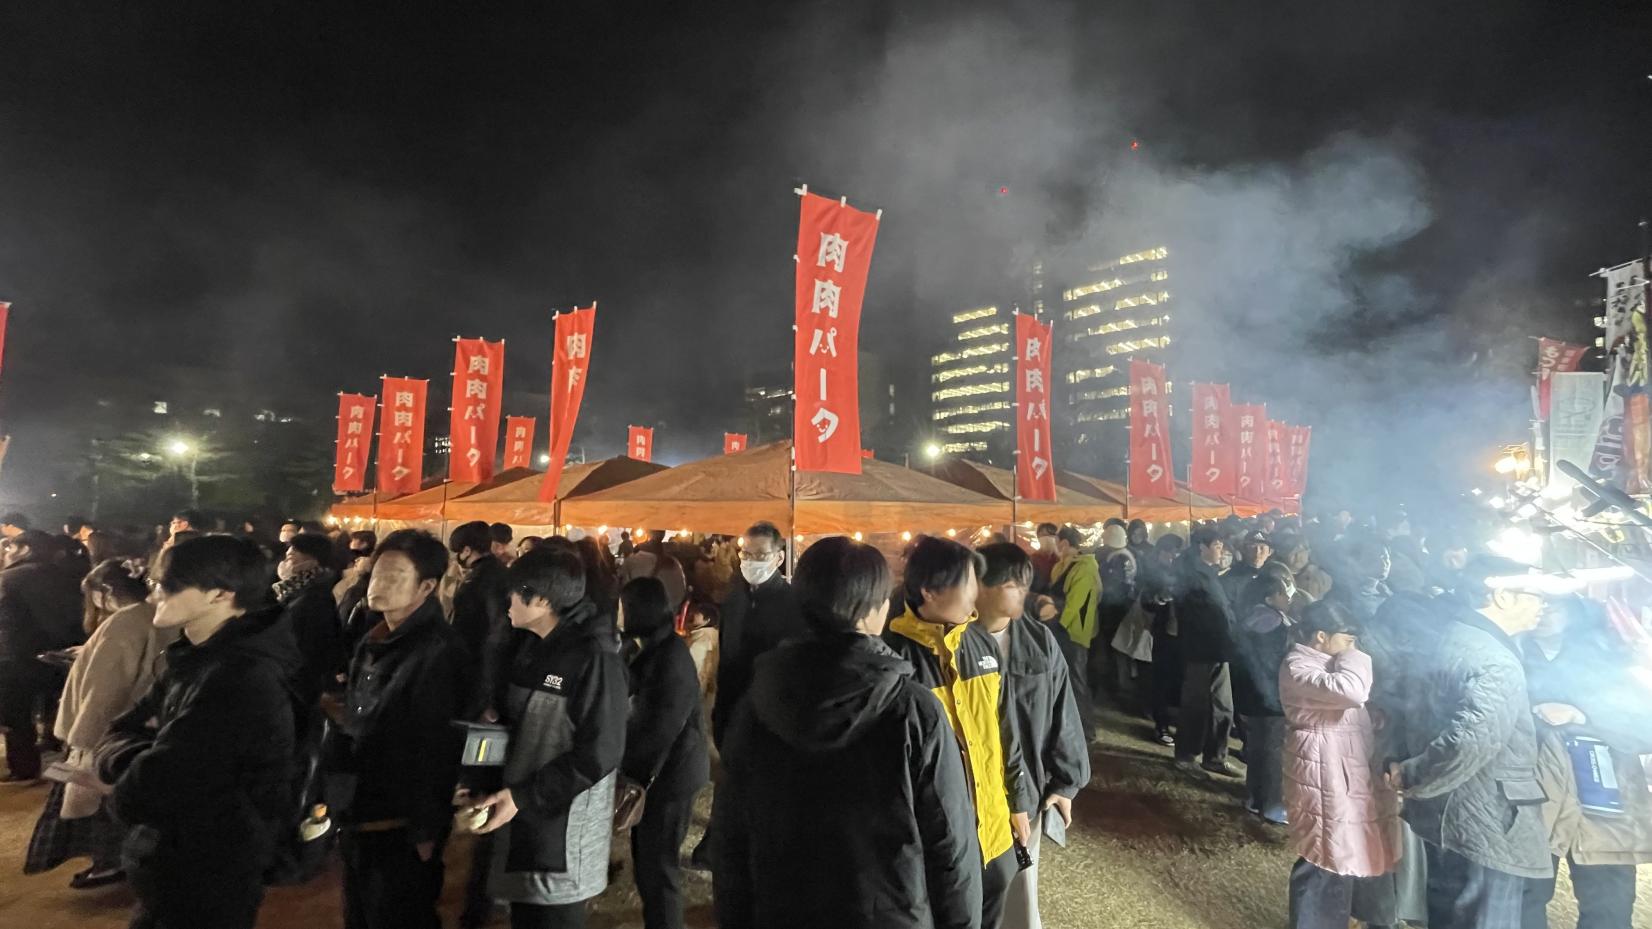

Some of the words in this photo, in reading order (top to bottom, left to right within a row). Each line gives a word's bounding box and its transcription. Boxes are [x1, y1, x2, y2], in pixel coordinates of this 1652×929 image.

[809, 232, 849, 444] 肉肉パーク
[341, 405, 365, 480] 肉肉パーク
[391, 391, 414, 481] 肉肉パーク
[463, 355, 489, 468] 肉肉パーク
[1025, 337, 1048, 481] 肉肉パーク
[1141, 377, 1164, 483] 肉肉パーク
[1203, 396, 1221, 483] 肉肉パーク
